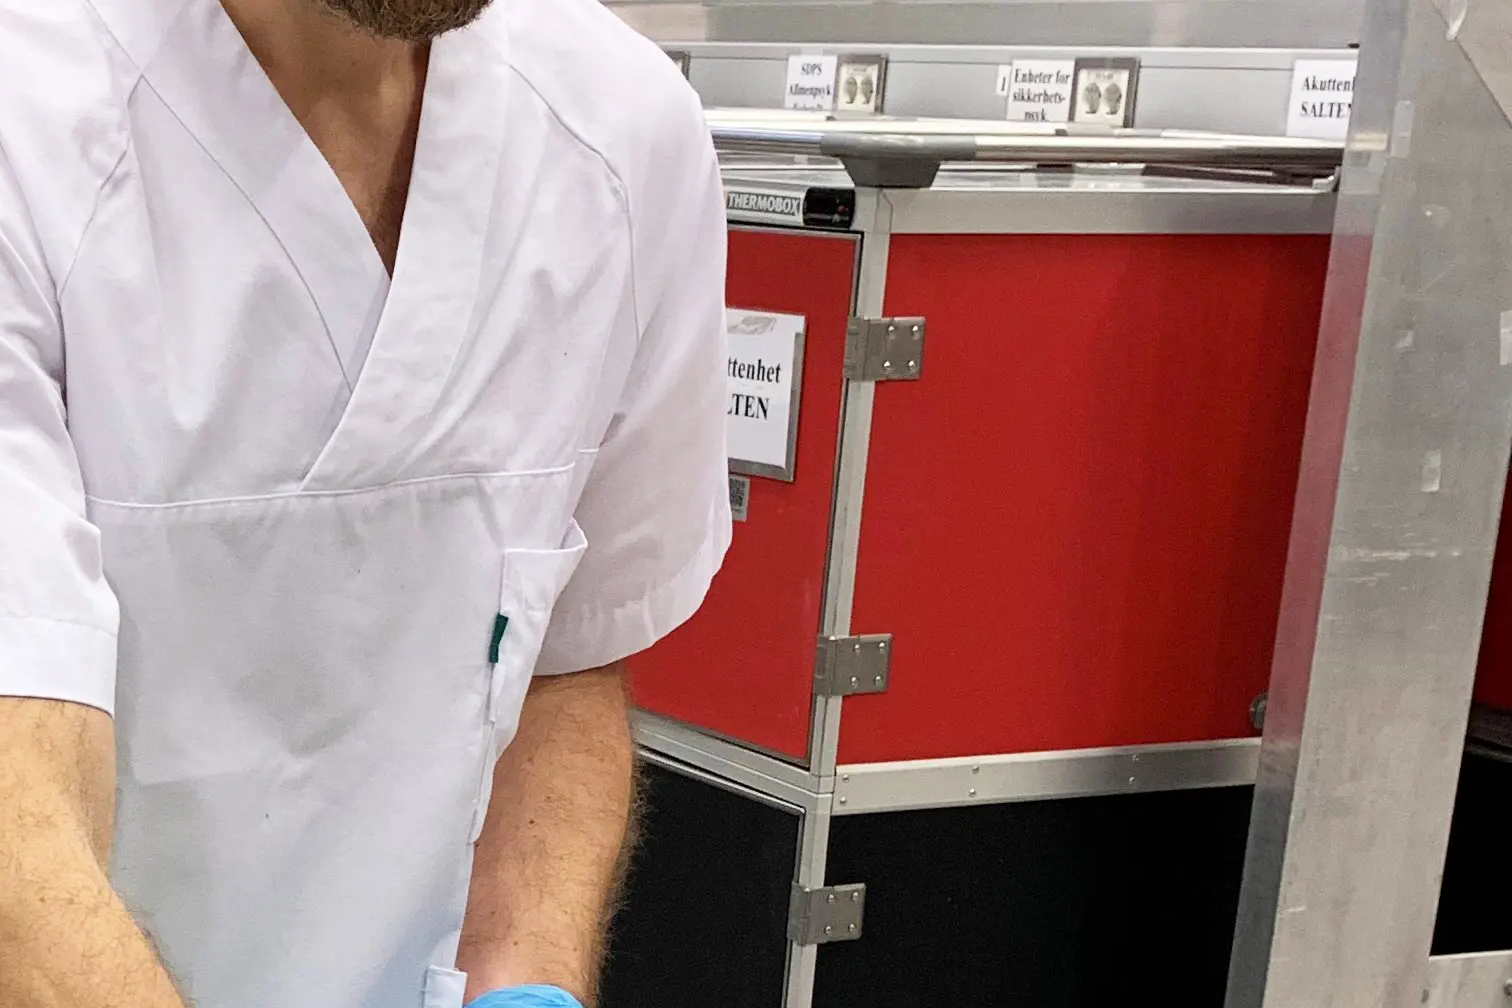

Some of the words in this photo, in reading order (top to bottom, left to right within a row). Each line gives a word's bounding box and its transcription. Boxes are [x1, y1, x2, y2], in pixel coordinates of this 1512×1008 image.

[1014, 68, 1053, 85] Enheter
[1055, 69, 1071, 85] for
[727, 191, 801, 217] THERMOBOX
[727, 393, 769, 420] TEN
